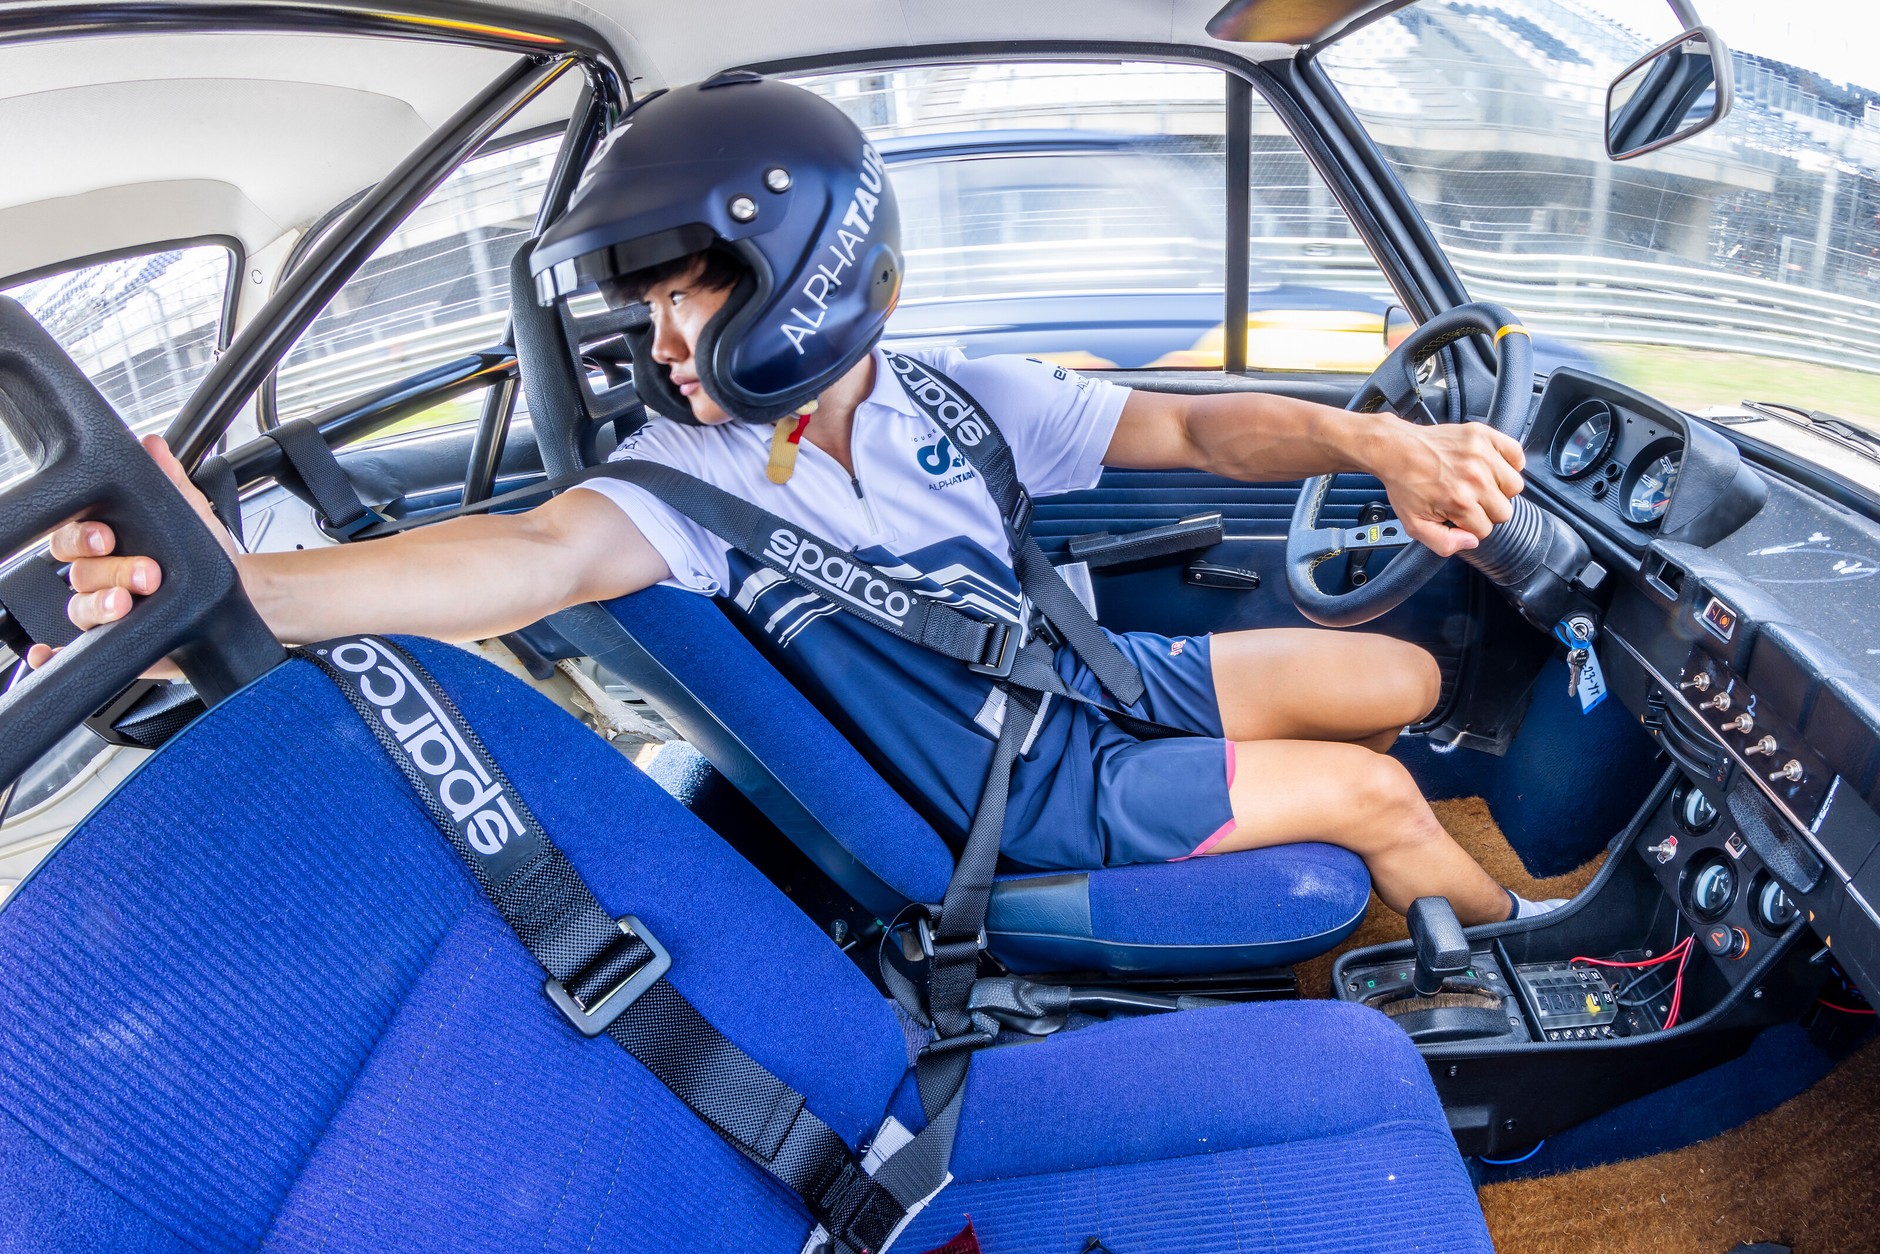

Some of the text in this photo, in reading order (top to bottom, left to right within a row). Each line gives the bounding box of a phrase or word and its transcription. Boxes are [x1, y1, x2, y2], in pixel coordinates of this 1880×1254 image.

[780, 134, 883, 354] ALPHATAUR
[769, 529, 910, 617] sparco
[331, 643, 509, 855] sparco
